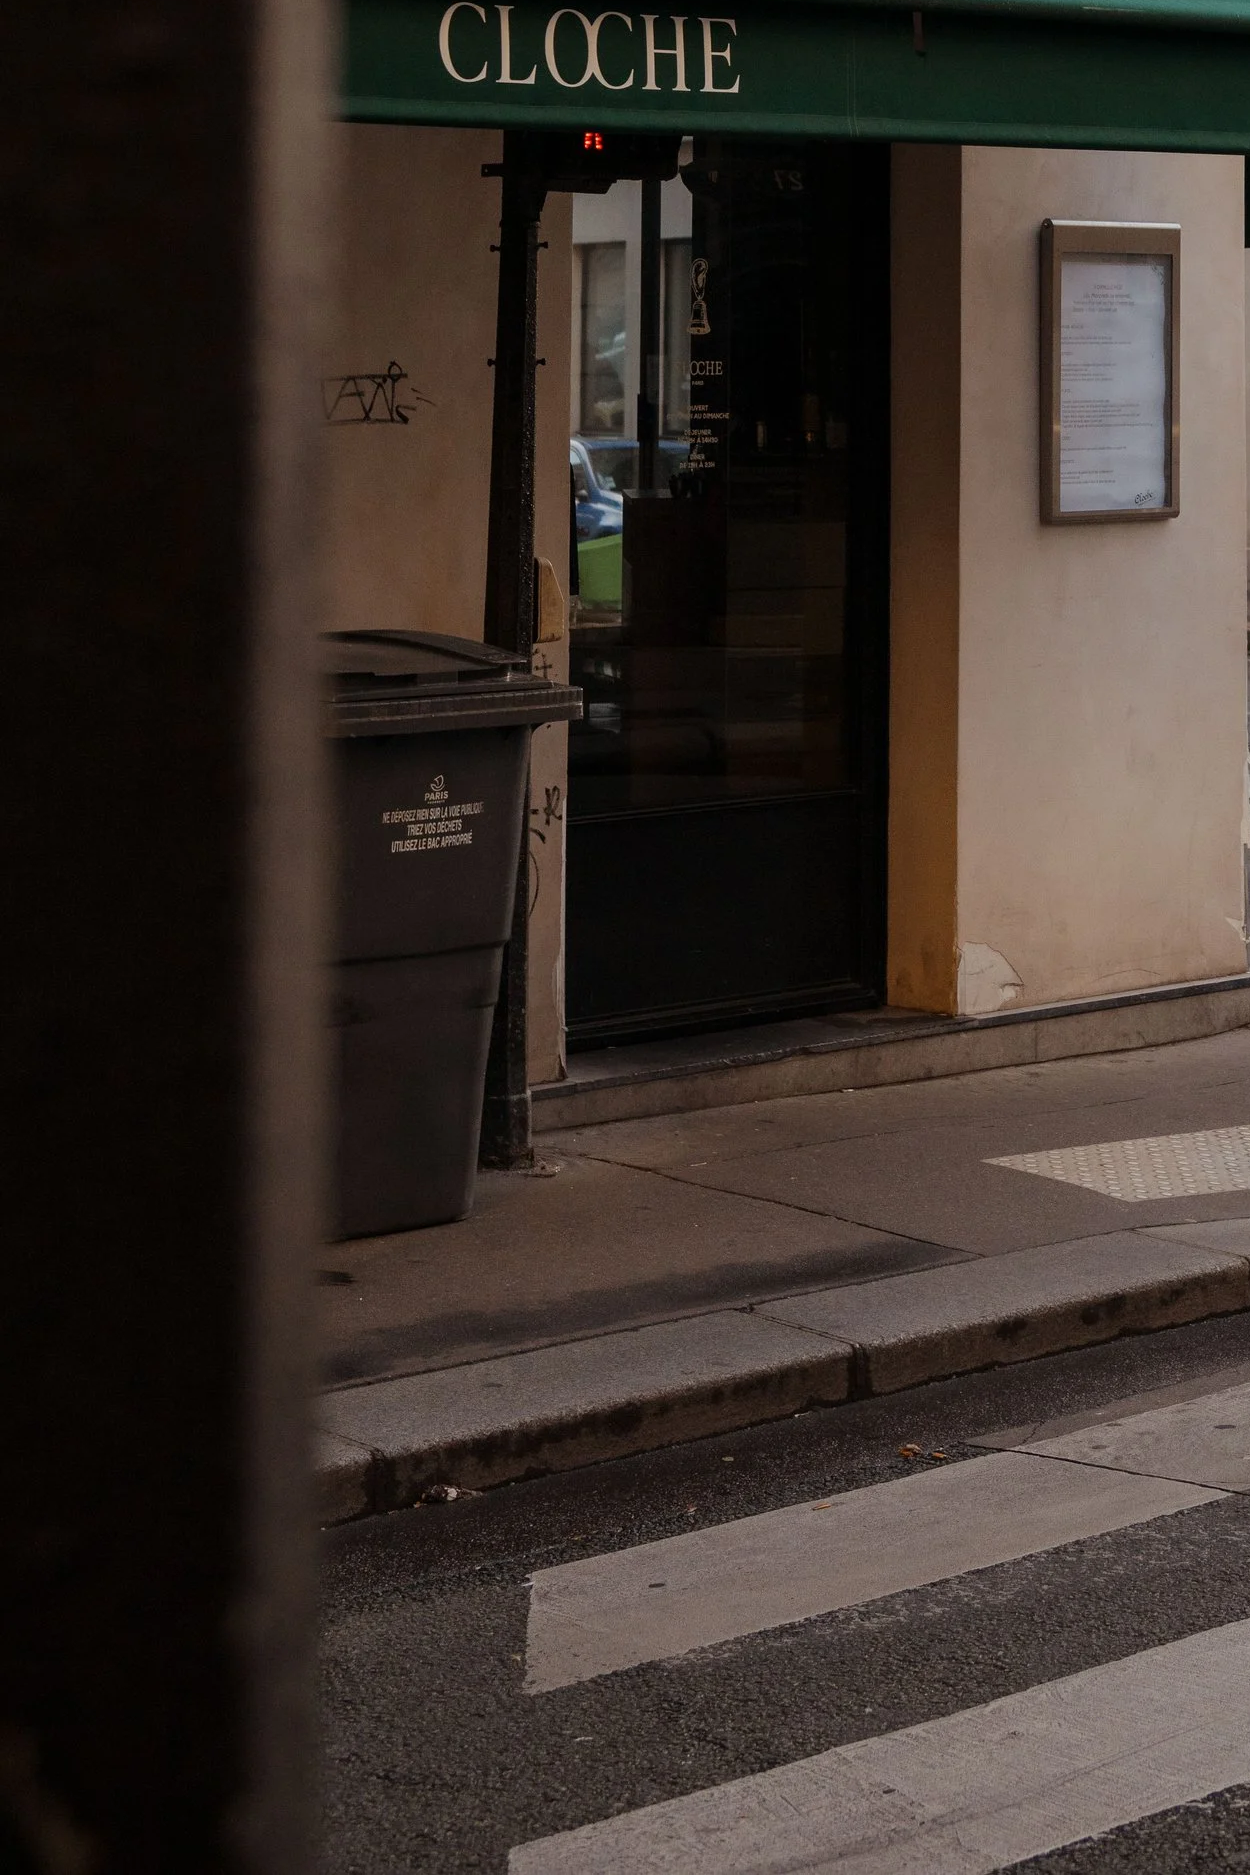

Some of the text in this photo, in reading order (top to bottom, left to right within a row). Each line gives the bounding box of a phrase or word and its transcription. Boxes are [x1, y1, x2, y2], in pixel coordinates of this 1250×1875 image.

[438, 1, 741, 94] CLOCHE
[672, 360, 723, 376] OCHE
[424, 791, 449, 801] PARIS
[382, 812, 391, 824] NE
[391, 808, 416, 823] DÉPOSEZ
[416, 809, 429, 821] RIEN
[429, 807, 441, 819] SUR
[441, 806, 448, 818] LA
[448, 805, 461, 817] VOIE
[407, 819, 463, 836] TRIEZ VOS DÉCHETS
[391, 829, 473, 853] UTILISEZ LE BAC APPROPRIÉ
